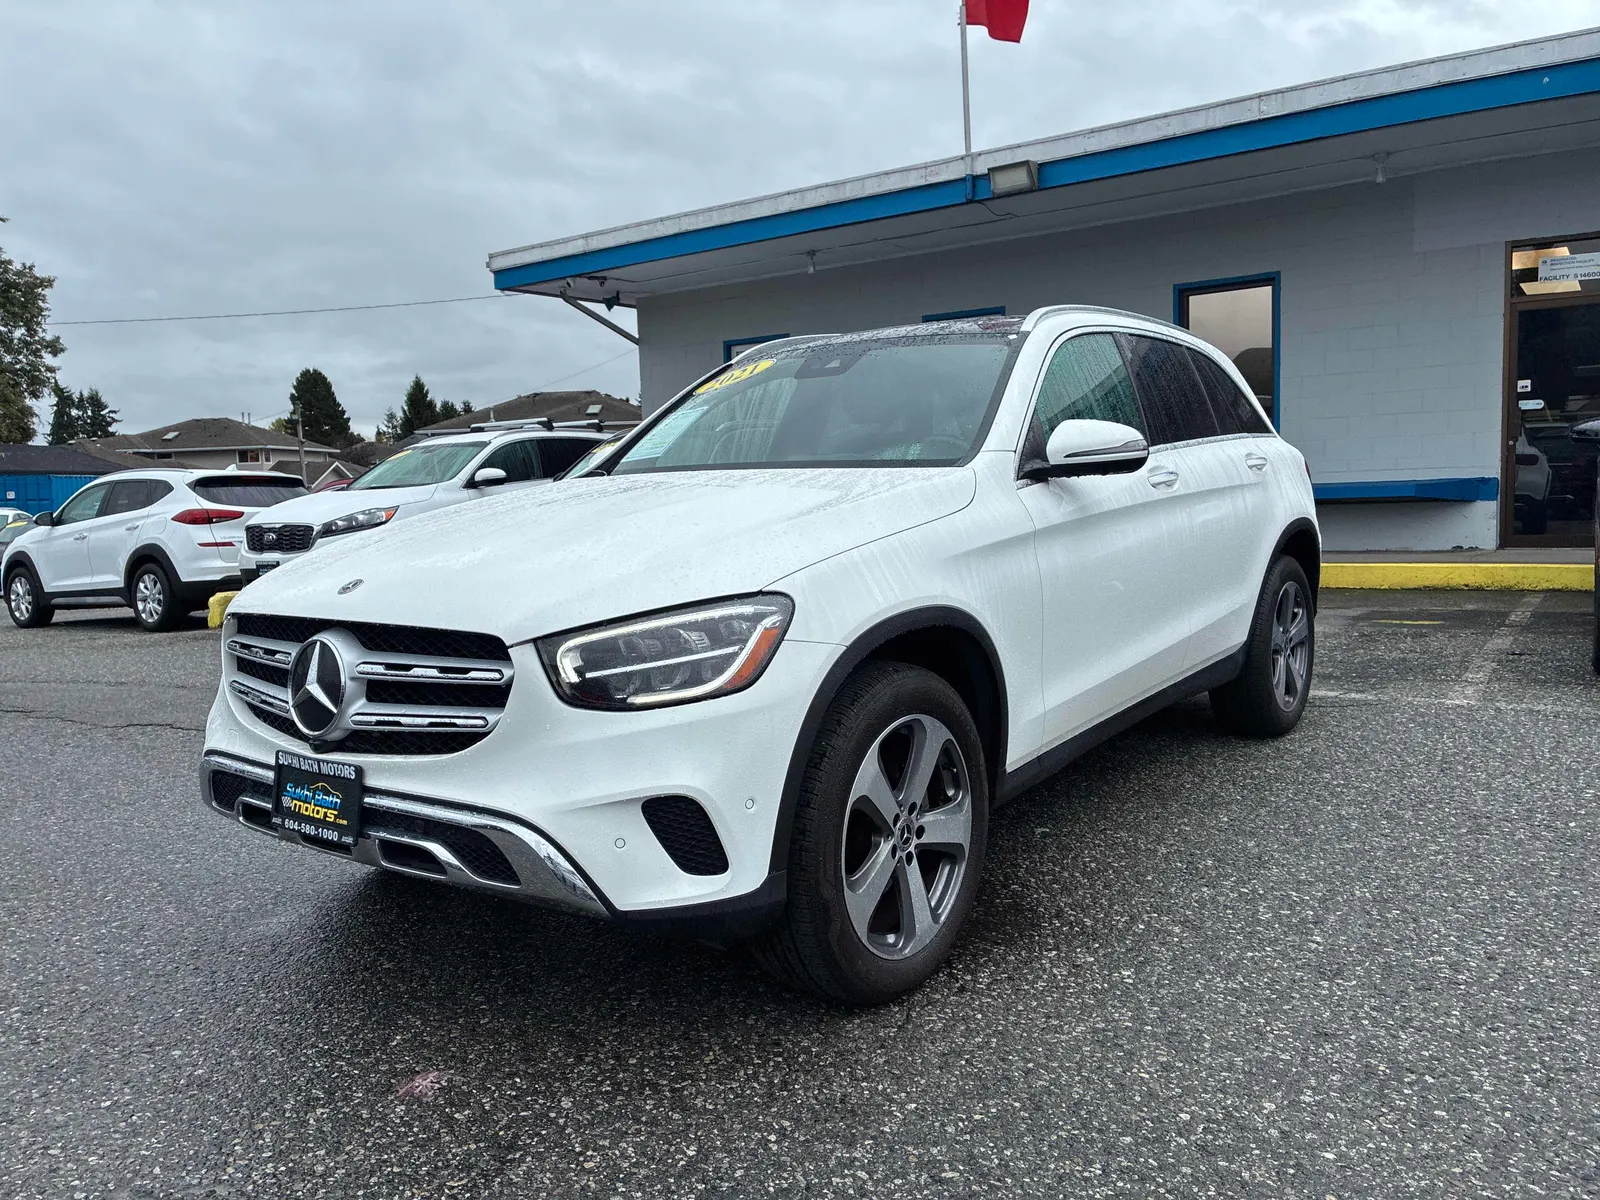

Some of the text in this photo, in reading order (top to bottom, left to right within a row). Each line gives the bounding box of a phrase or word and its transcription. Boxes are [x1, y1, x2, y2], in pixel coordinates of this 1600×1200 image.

[704, 363, 760, 388] 2021
[300, 757, 319, 774] BATH
[319, 761, 356, 780] MOTORS
[283, 782, 341, 810] Sukhi Bath
[284, 818, 339, 841] 604-580-1000
